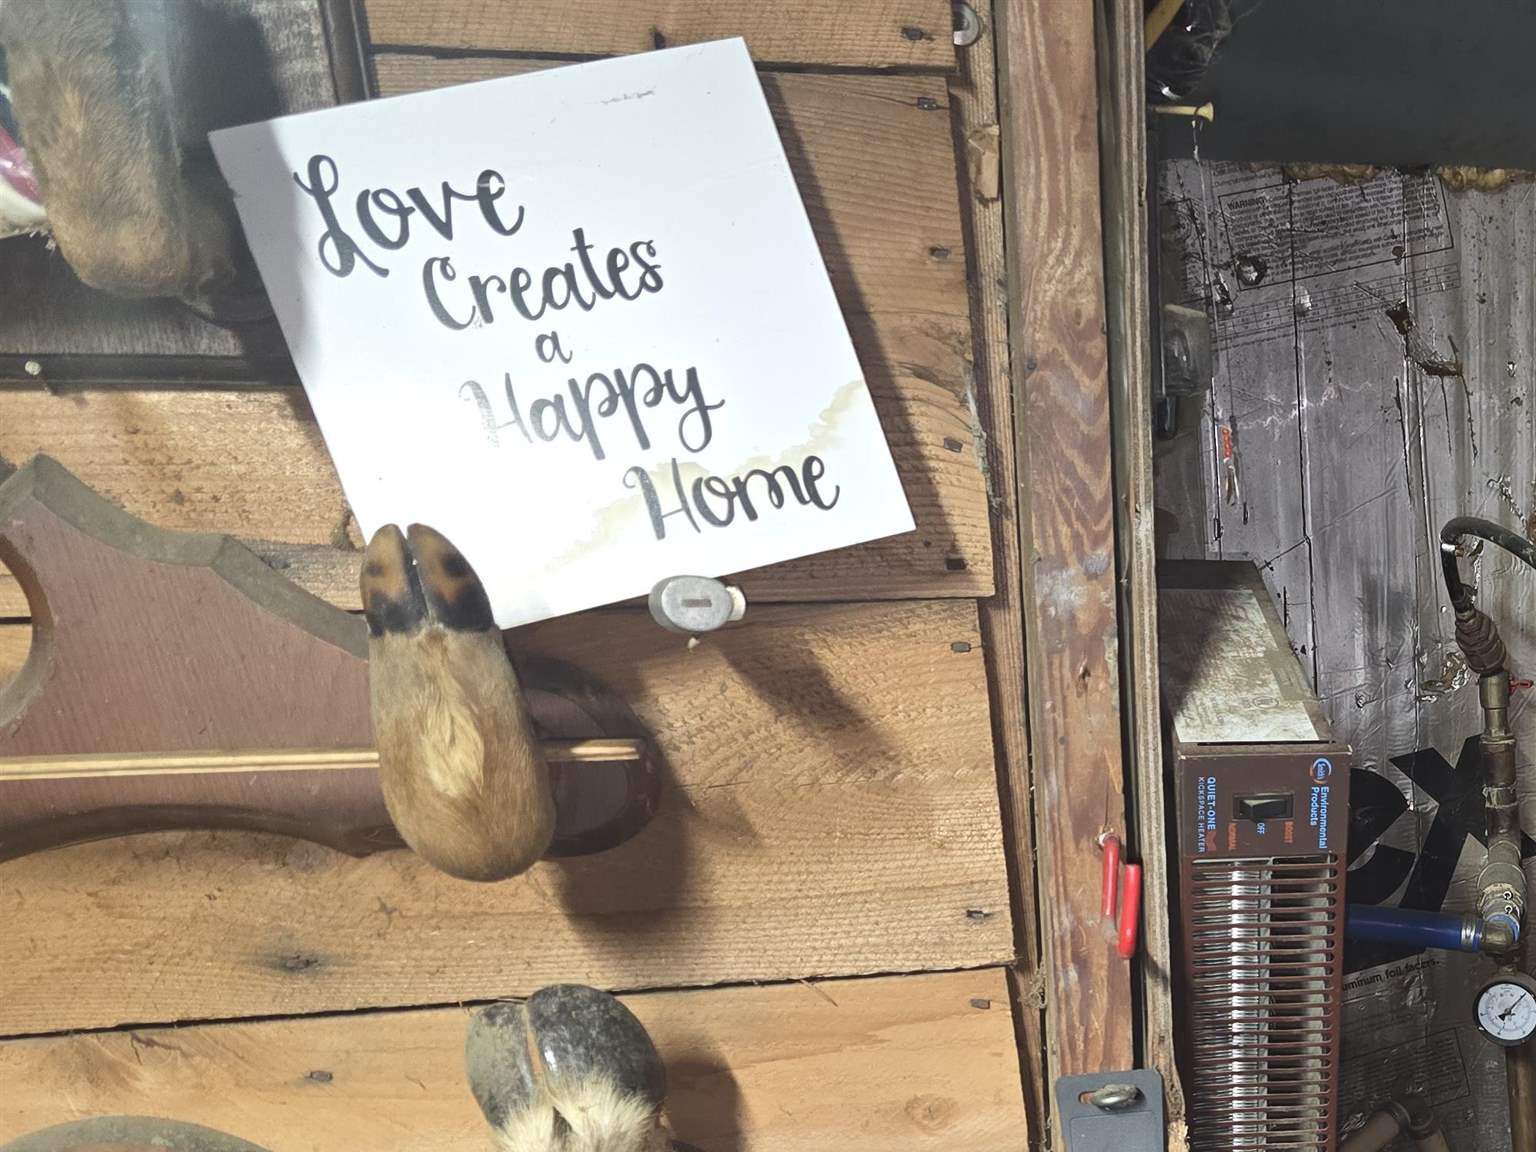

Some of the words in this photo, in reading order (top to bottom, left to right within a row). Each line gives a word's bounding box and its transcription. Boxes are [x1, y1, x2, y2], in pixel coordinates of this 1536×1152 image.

[293, 154, 524, 278] Love
[421, 226, 664, 331] Creates
[534, 330, 573, 364] a
[458, 361, 725, 460] Happy
[622, 454, 840, 541] Home
[1198, 777, 1206, 822] KICKSPACE
[1207, 777, 1216, 830] QUIET-ONE
[1310, 786, 1319, 827] Products
[1318, 786, 1329, 849] Environmental
[1198, 824, 1206, 853] HEATER
[1257, 822, 1265, 835] OFF
[1385, 968, 1402, 981] foil
